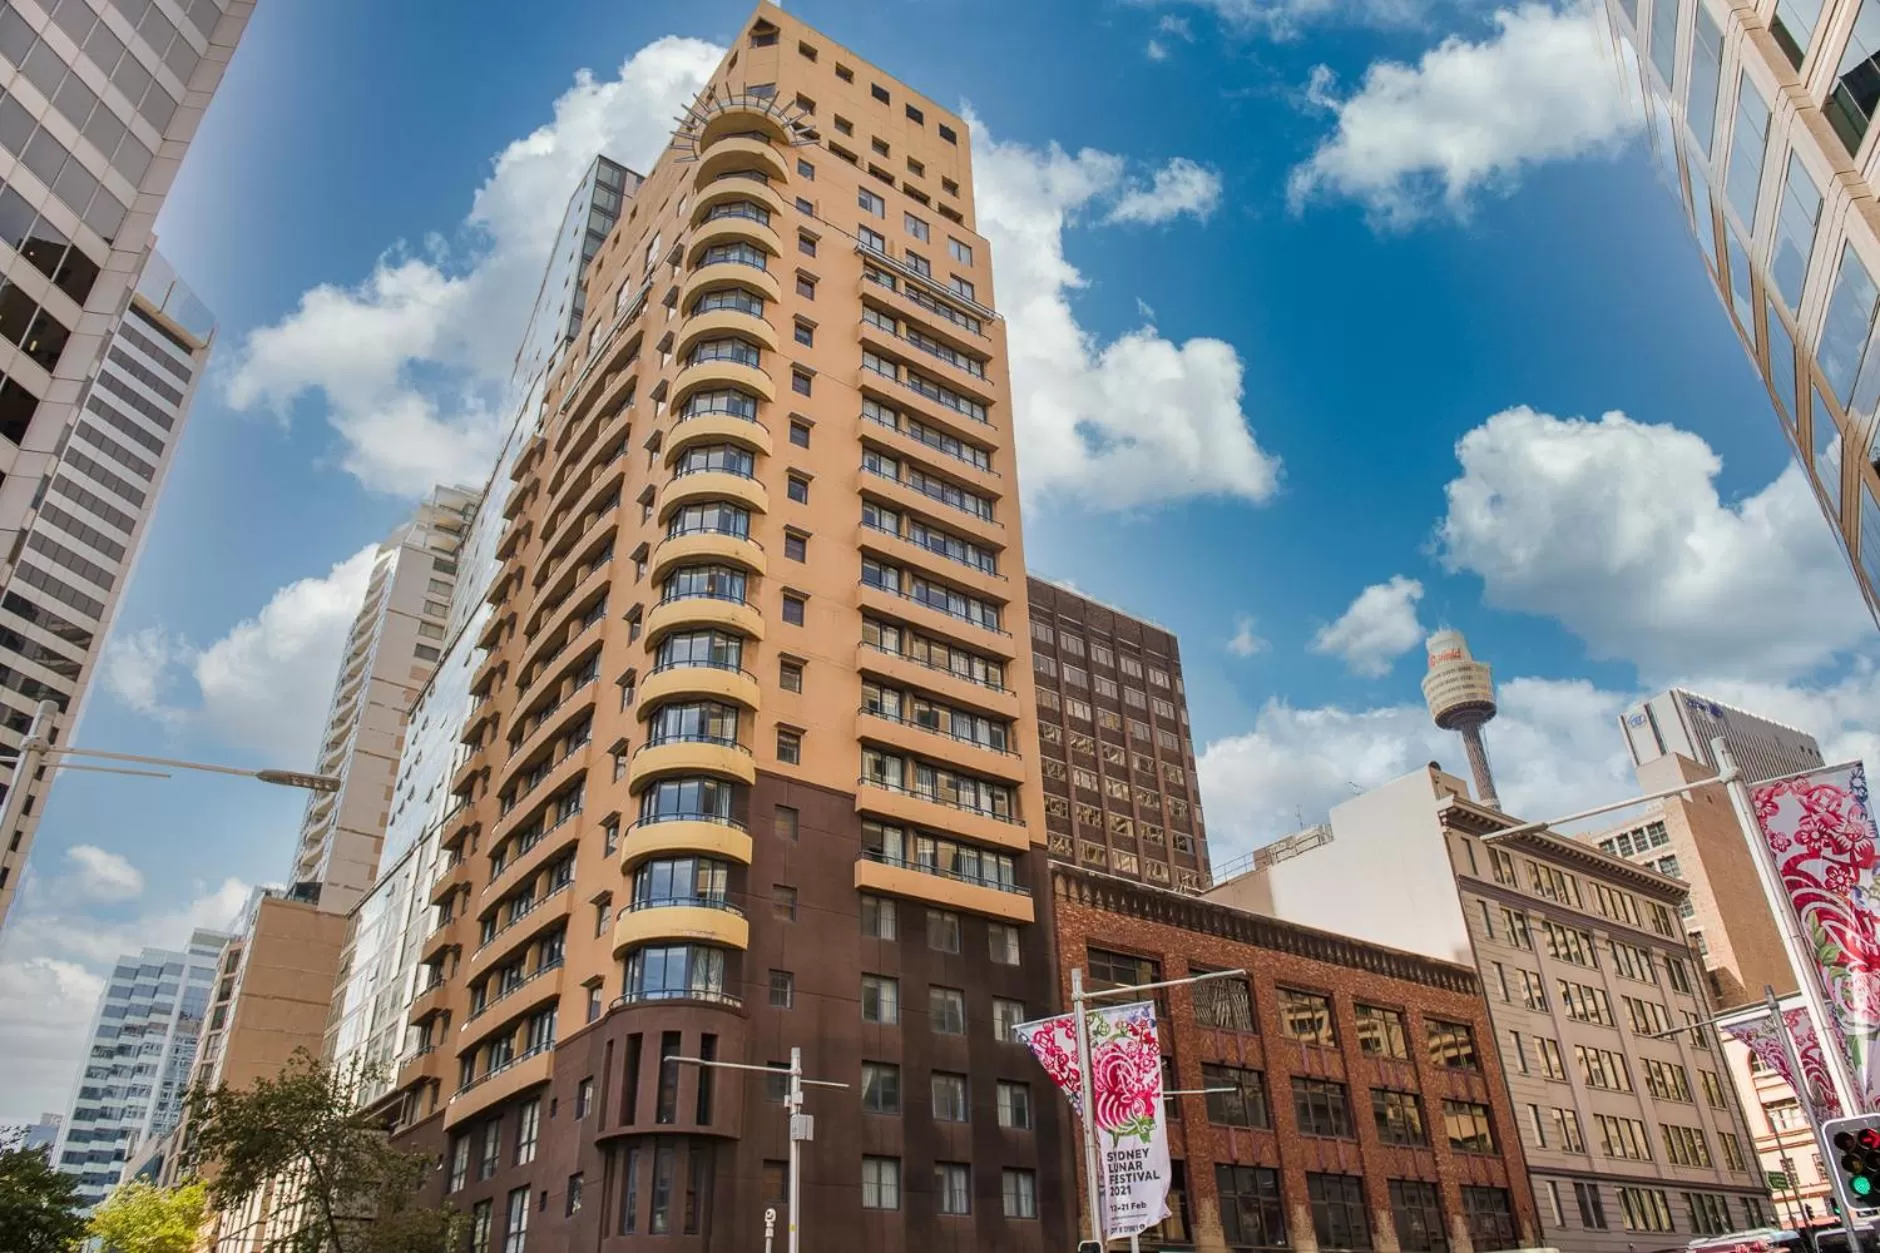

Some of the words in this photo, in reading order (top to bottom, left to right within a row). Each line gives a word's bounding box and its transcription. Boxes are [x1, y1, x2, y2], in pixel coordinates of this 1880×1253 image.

[1108, 1161, 1143, 1173] LUNAR
[1109, 1170, 1161, 1184] FESTIVAL
[1110, 1185, 1132, 1197] 2021
[1131, 1201, 1147, 1209] Feb
